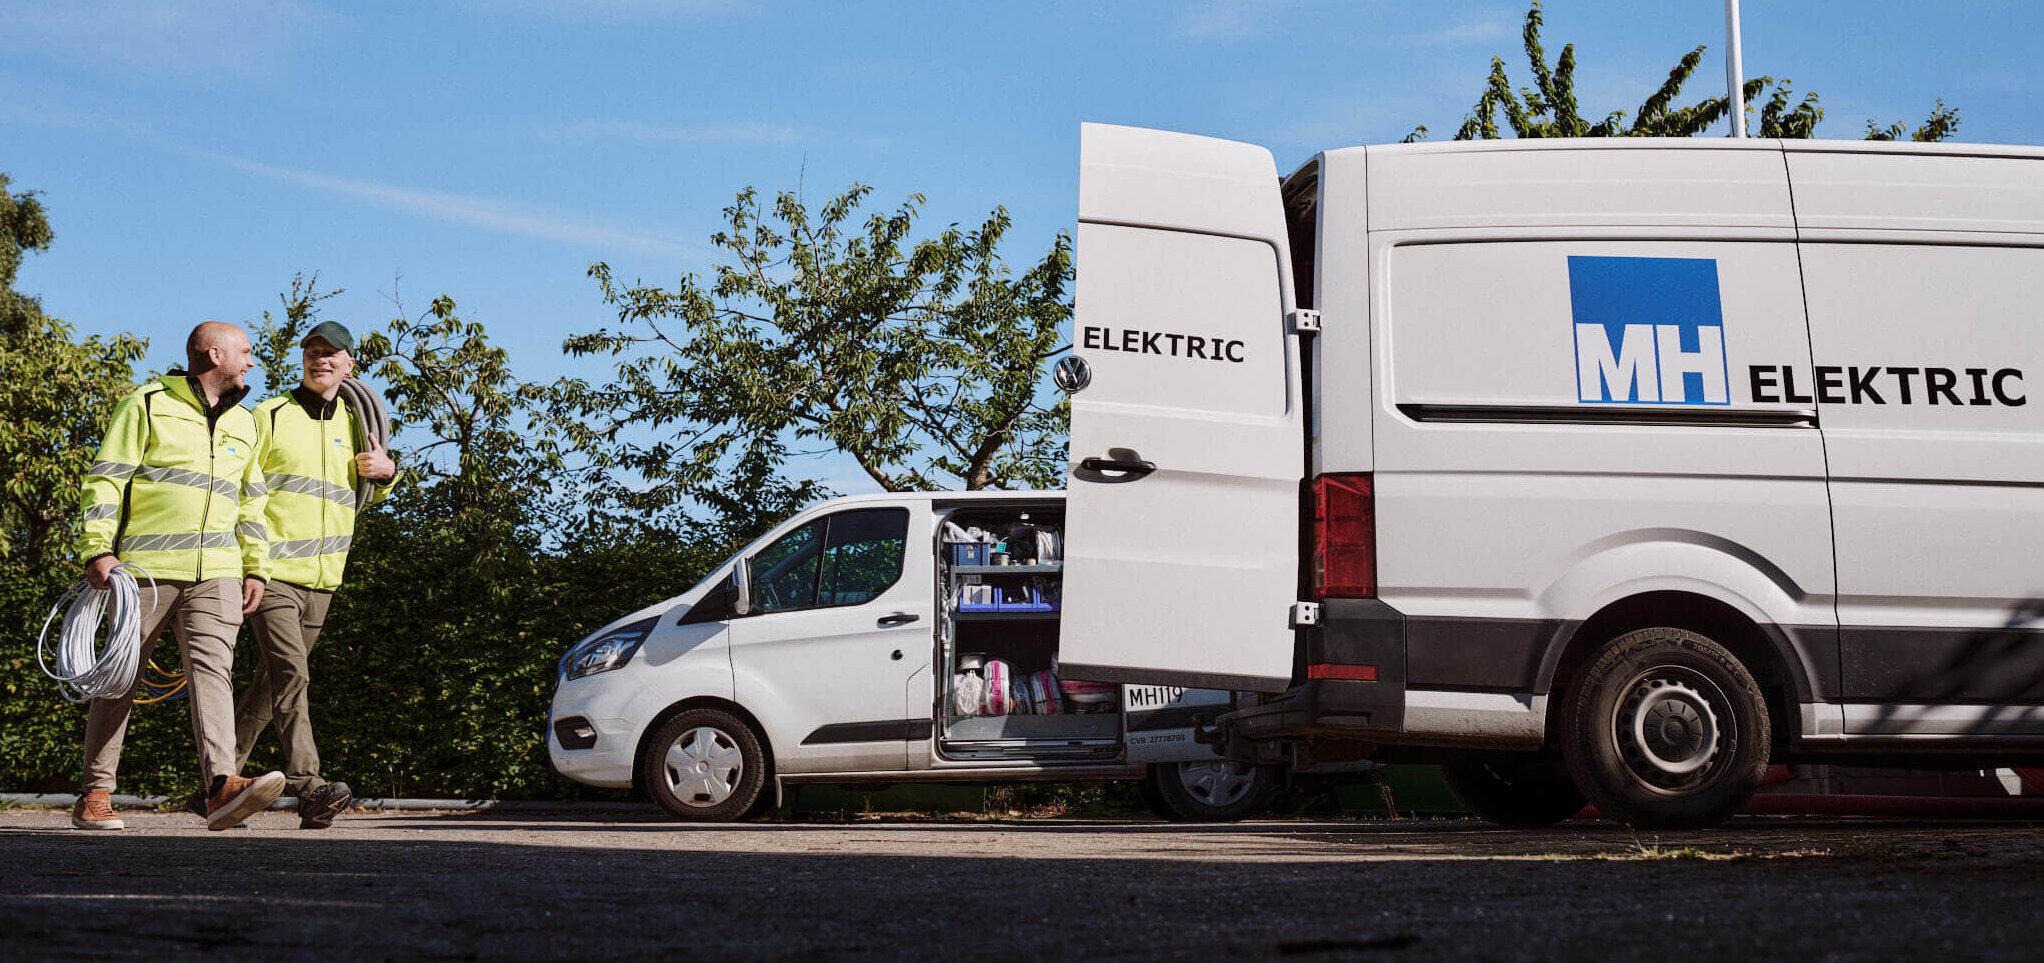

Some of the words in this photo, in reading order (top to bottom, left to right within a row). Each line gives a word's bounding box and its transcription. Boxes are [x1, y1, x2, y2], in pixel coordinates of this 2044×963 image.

[1083, 326, 1245, 363] ELEKTRIC
[1575, 323, 1727, 402] MH
[1748, 365, 2027, 407] ELEKTRIC
[1129, 686, 1183, 706] MH119
